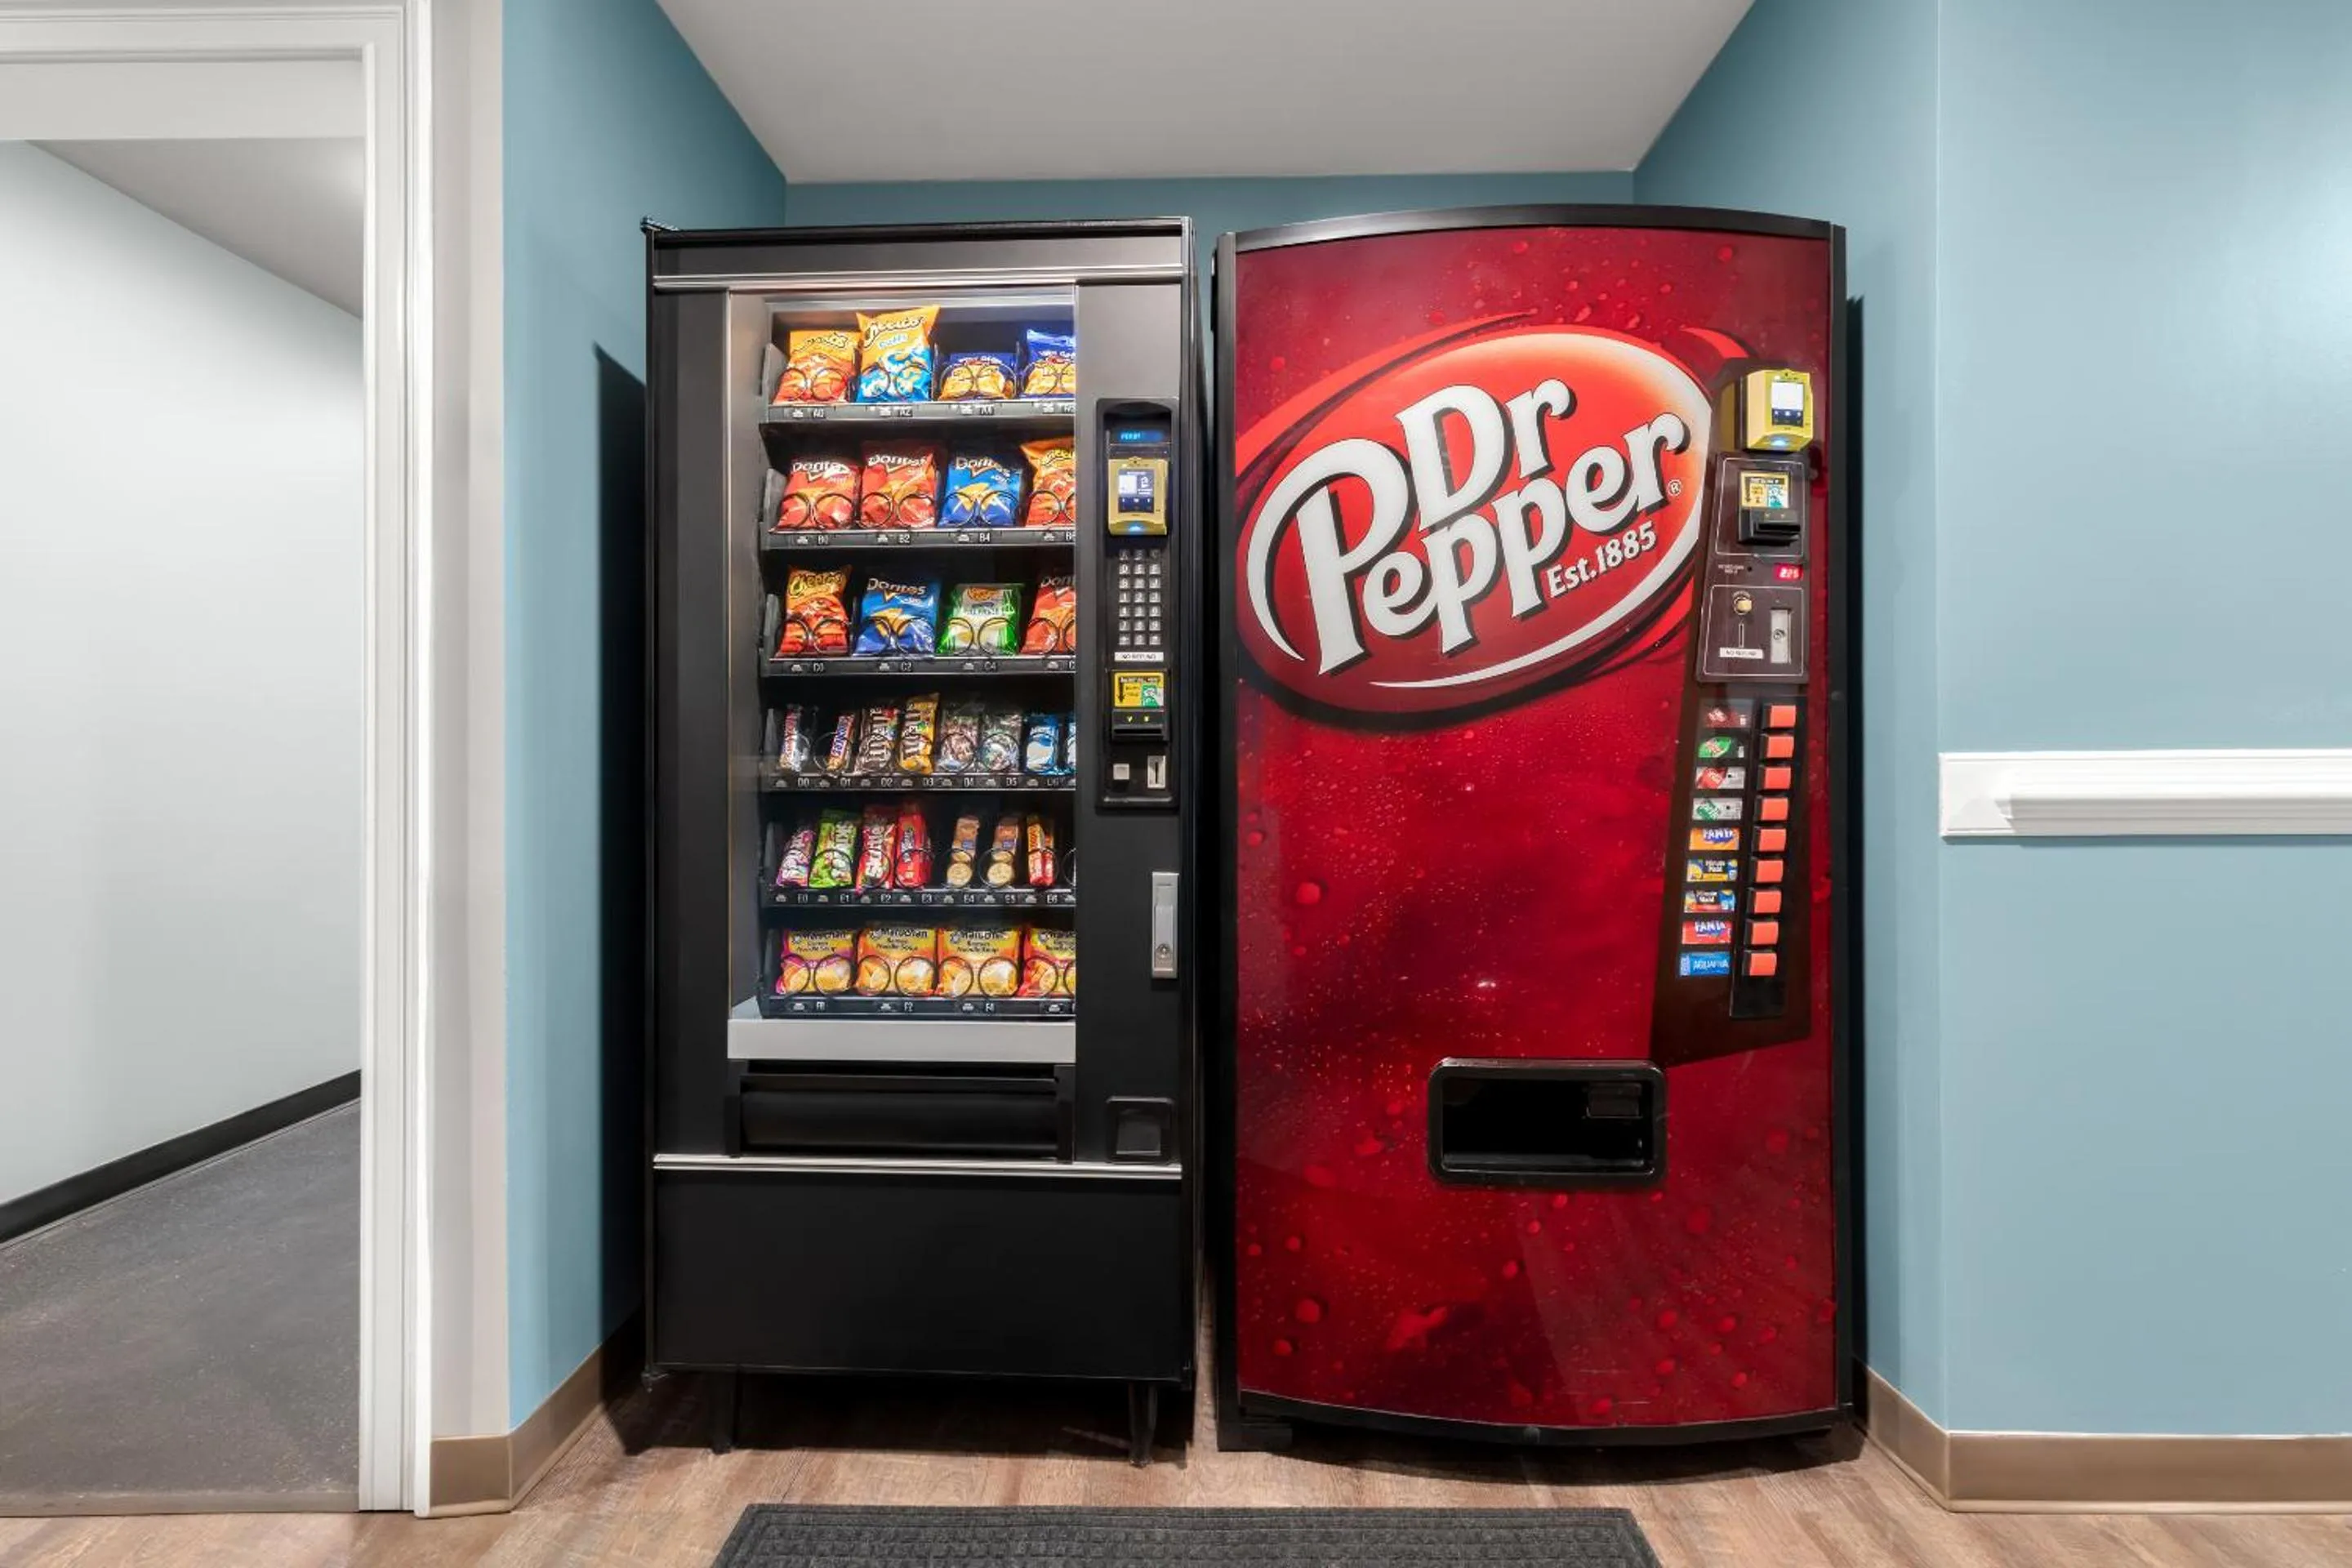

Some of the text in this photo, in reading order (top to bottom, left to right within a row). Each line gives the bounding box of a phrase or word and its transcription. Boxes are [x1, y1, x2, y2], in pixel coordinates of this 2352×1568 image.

[1395, 378, 1576, 531] Dr
[980, 532, 991, 542] B4
[1246, 412, 1690, 676] Pepper
[984, 661, 996, 670] C4
